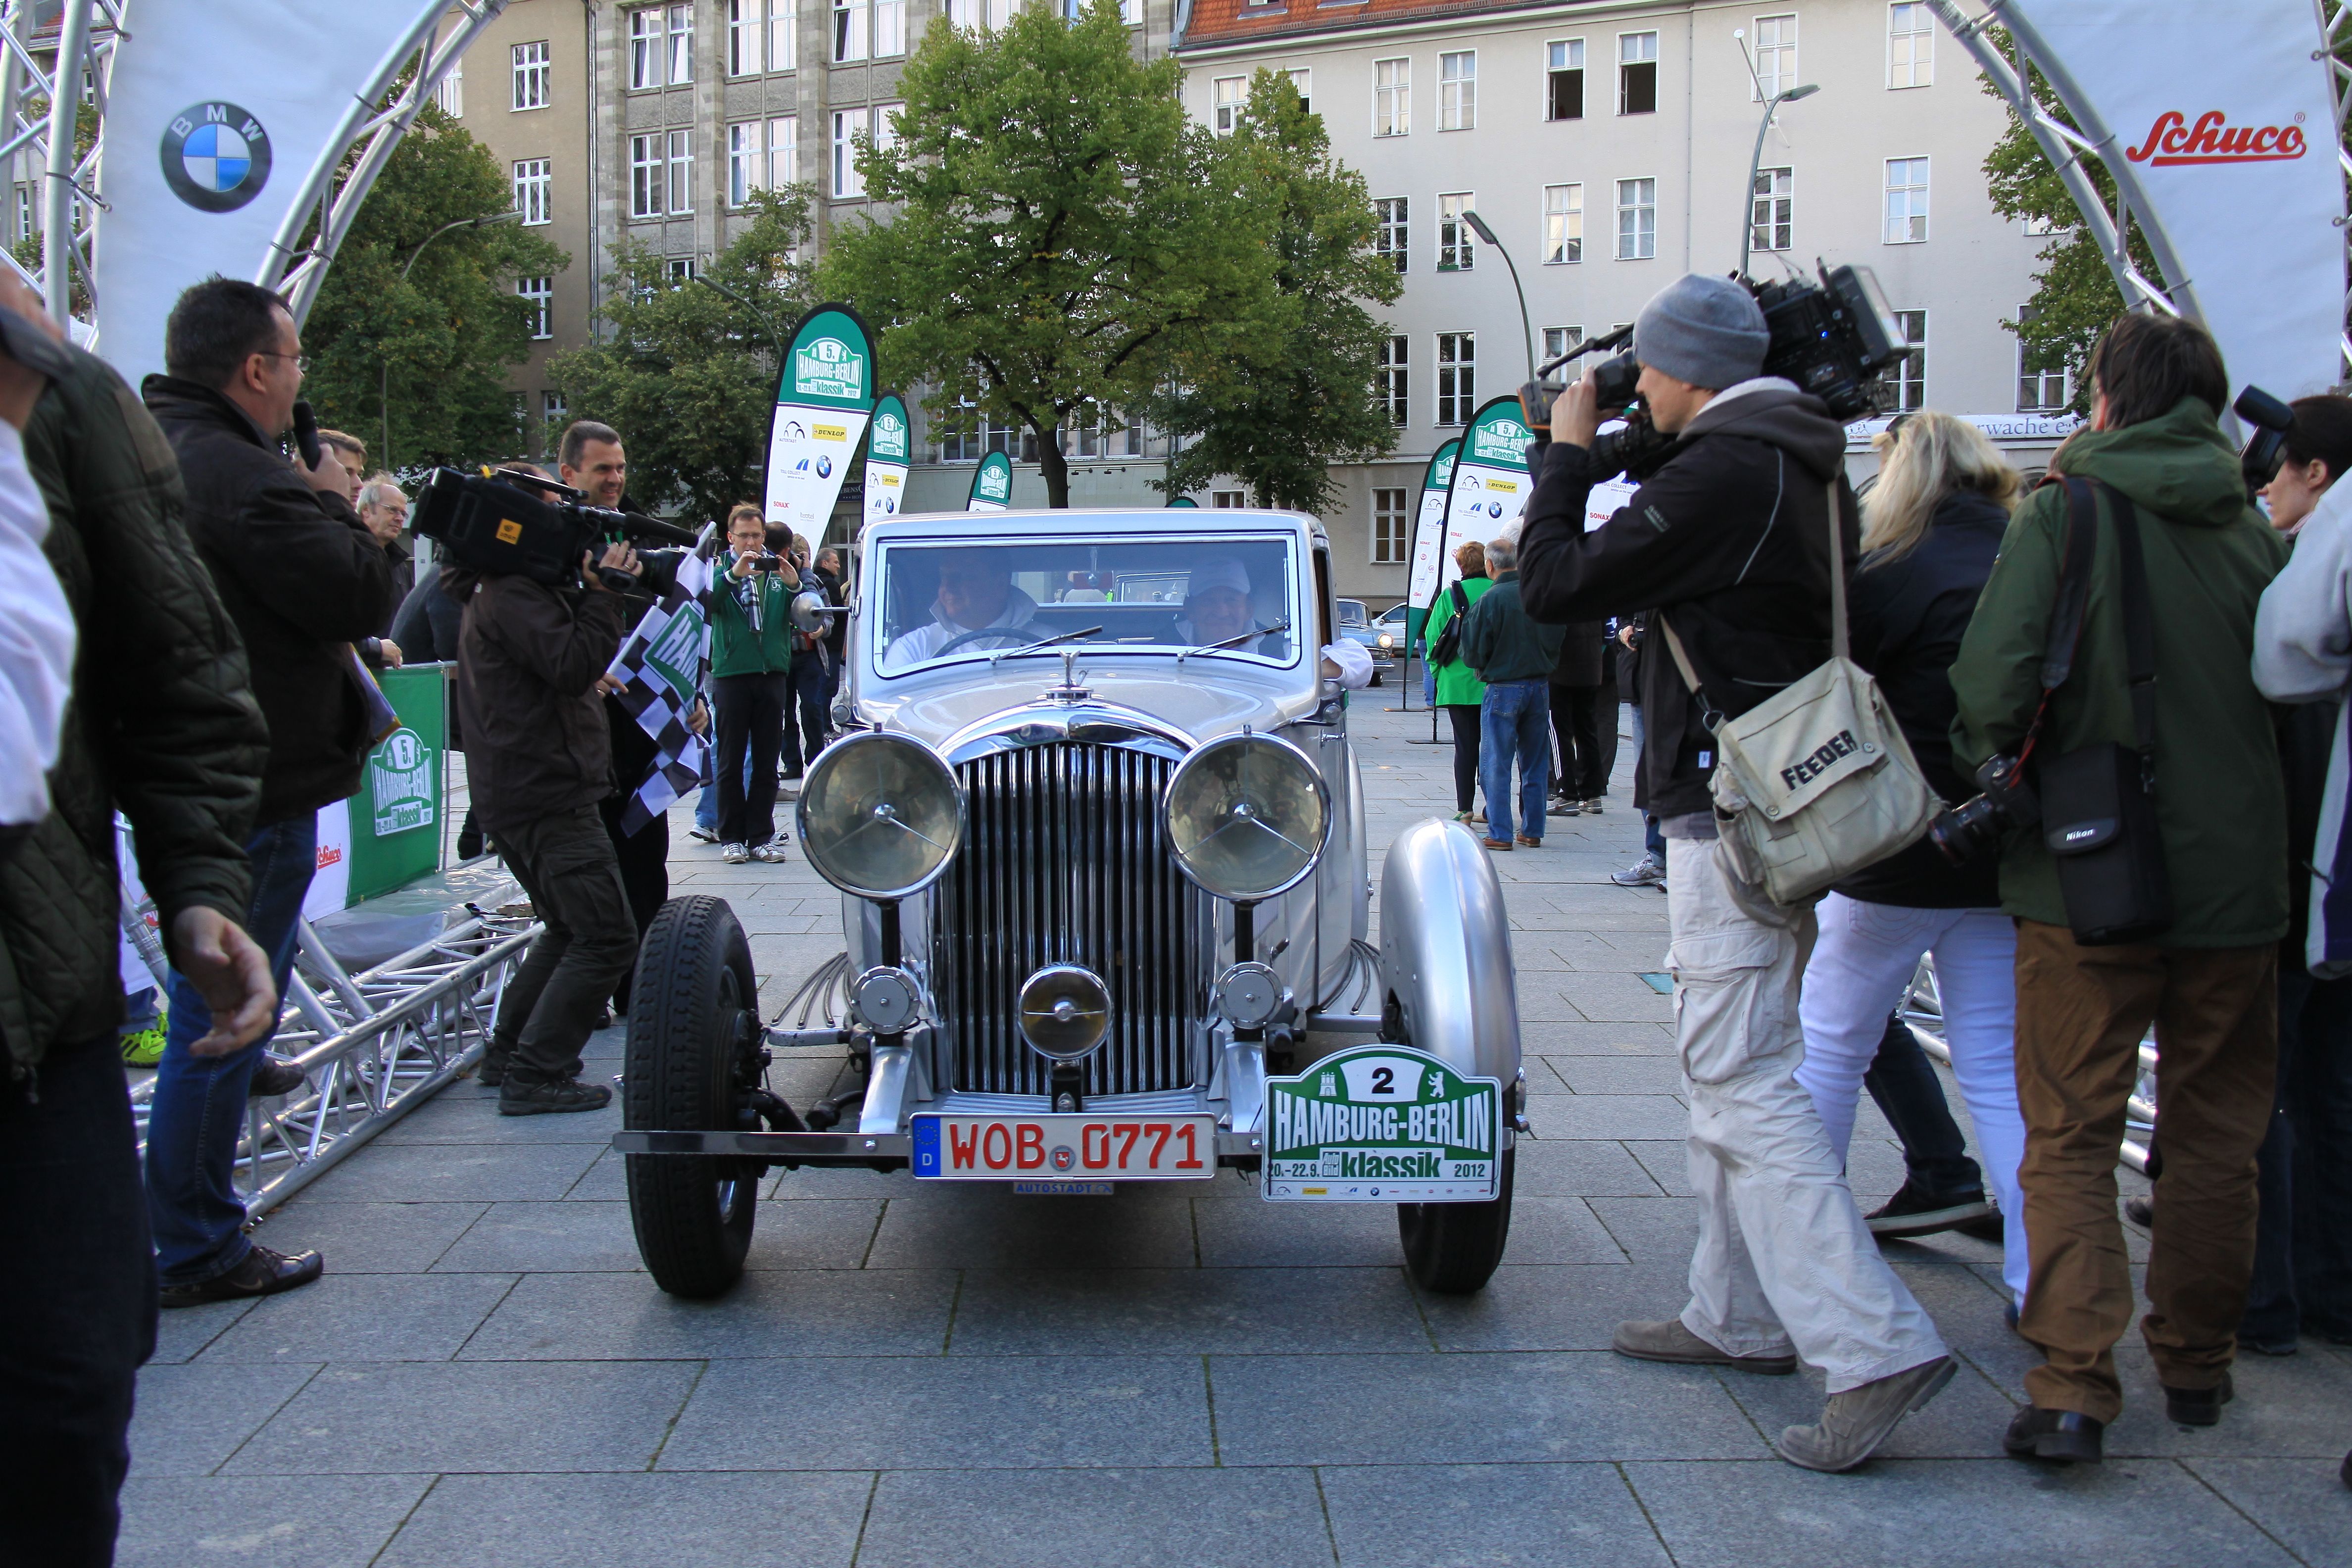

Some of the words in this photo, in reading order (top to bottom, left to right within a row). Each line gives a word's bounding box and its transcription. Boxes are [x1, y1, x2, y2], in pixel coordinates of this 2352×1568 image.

[171, 104, 264, 142] BMW
[2125, 111, 2307, 167] Schuco
[826, 344, 835, 359] 5.
[799, 353, 860, 387] HAMBURG-BERLIN
[817, 381, 844, 395] klassik
[1503, 424, 1511, 435] 5.
[1492, 449, 1518, 461] klassik
[1589, 512, 1610, 521] SONAX
[400, 739, 411, 765] 5.
[1780, 730, 1858, 791] FEEDER
[2066, 829, 2094, 841] Nikon
[1371, 1067, 1394, 1094] 2
[1275, 1089, 1489, 1153] HAMBURG-BERLIN
[948, 1123, 1046, 1170] WOB
[1081, 1123, 1203, 1170] 0771
[922, 1153, 932, 1167] D
[1341, 1151, 1441, 1177] klassik
[1454, 1163, 1485, 1177] 2012
[1016, 1183, 1091, 1193] AUTOSTADT
